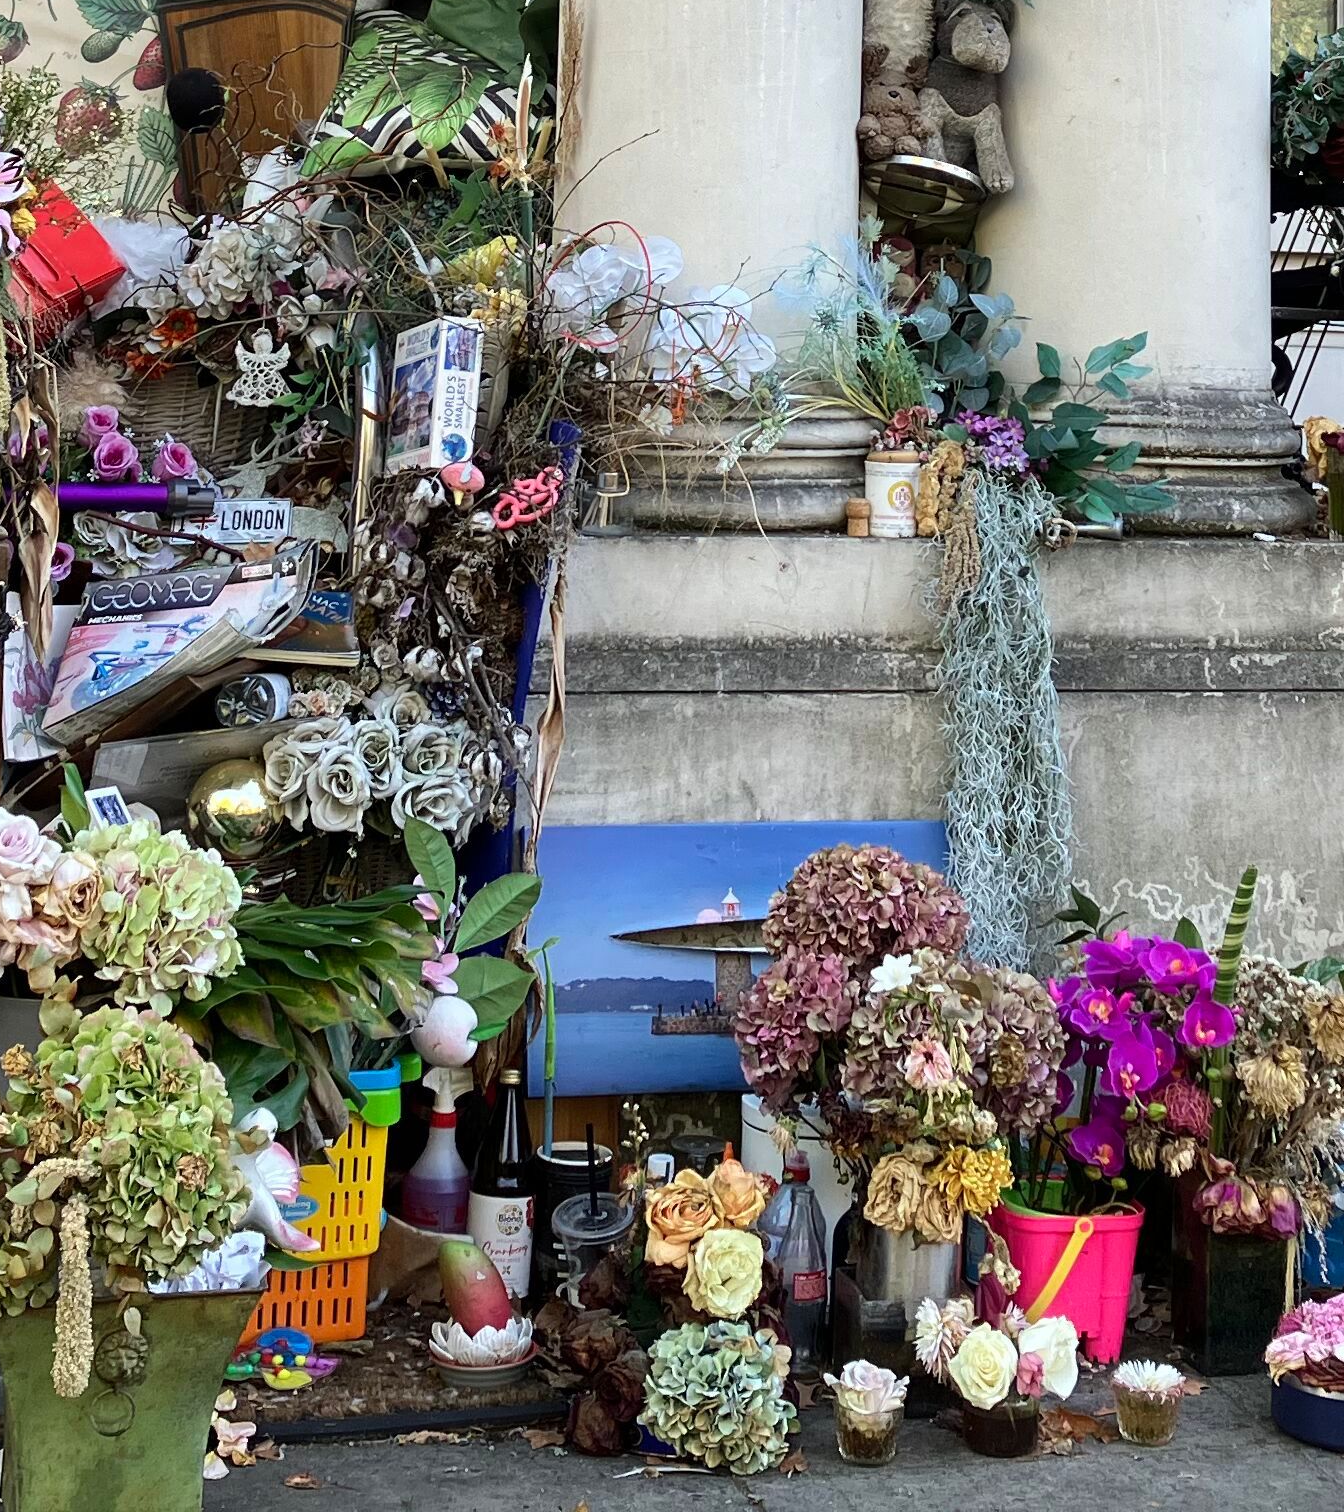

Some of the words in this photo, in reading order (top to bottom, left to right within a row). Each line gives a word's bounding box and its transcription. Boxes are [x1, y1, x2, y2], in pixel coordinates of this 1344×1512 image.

[443, 375, 457, 429] WORLD'S
[454, 377, 467, 429] SMALLEST
[220, 509, 285, 531] LONDON
[281, 561, 294, 573] 5+
[91, 573, 214, 612] GEOMAG
[87, 613, 144, 625] MECHANICS
